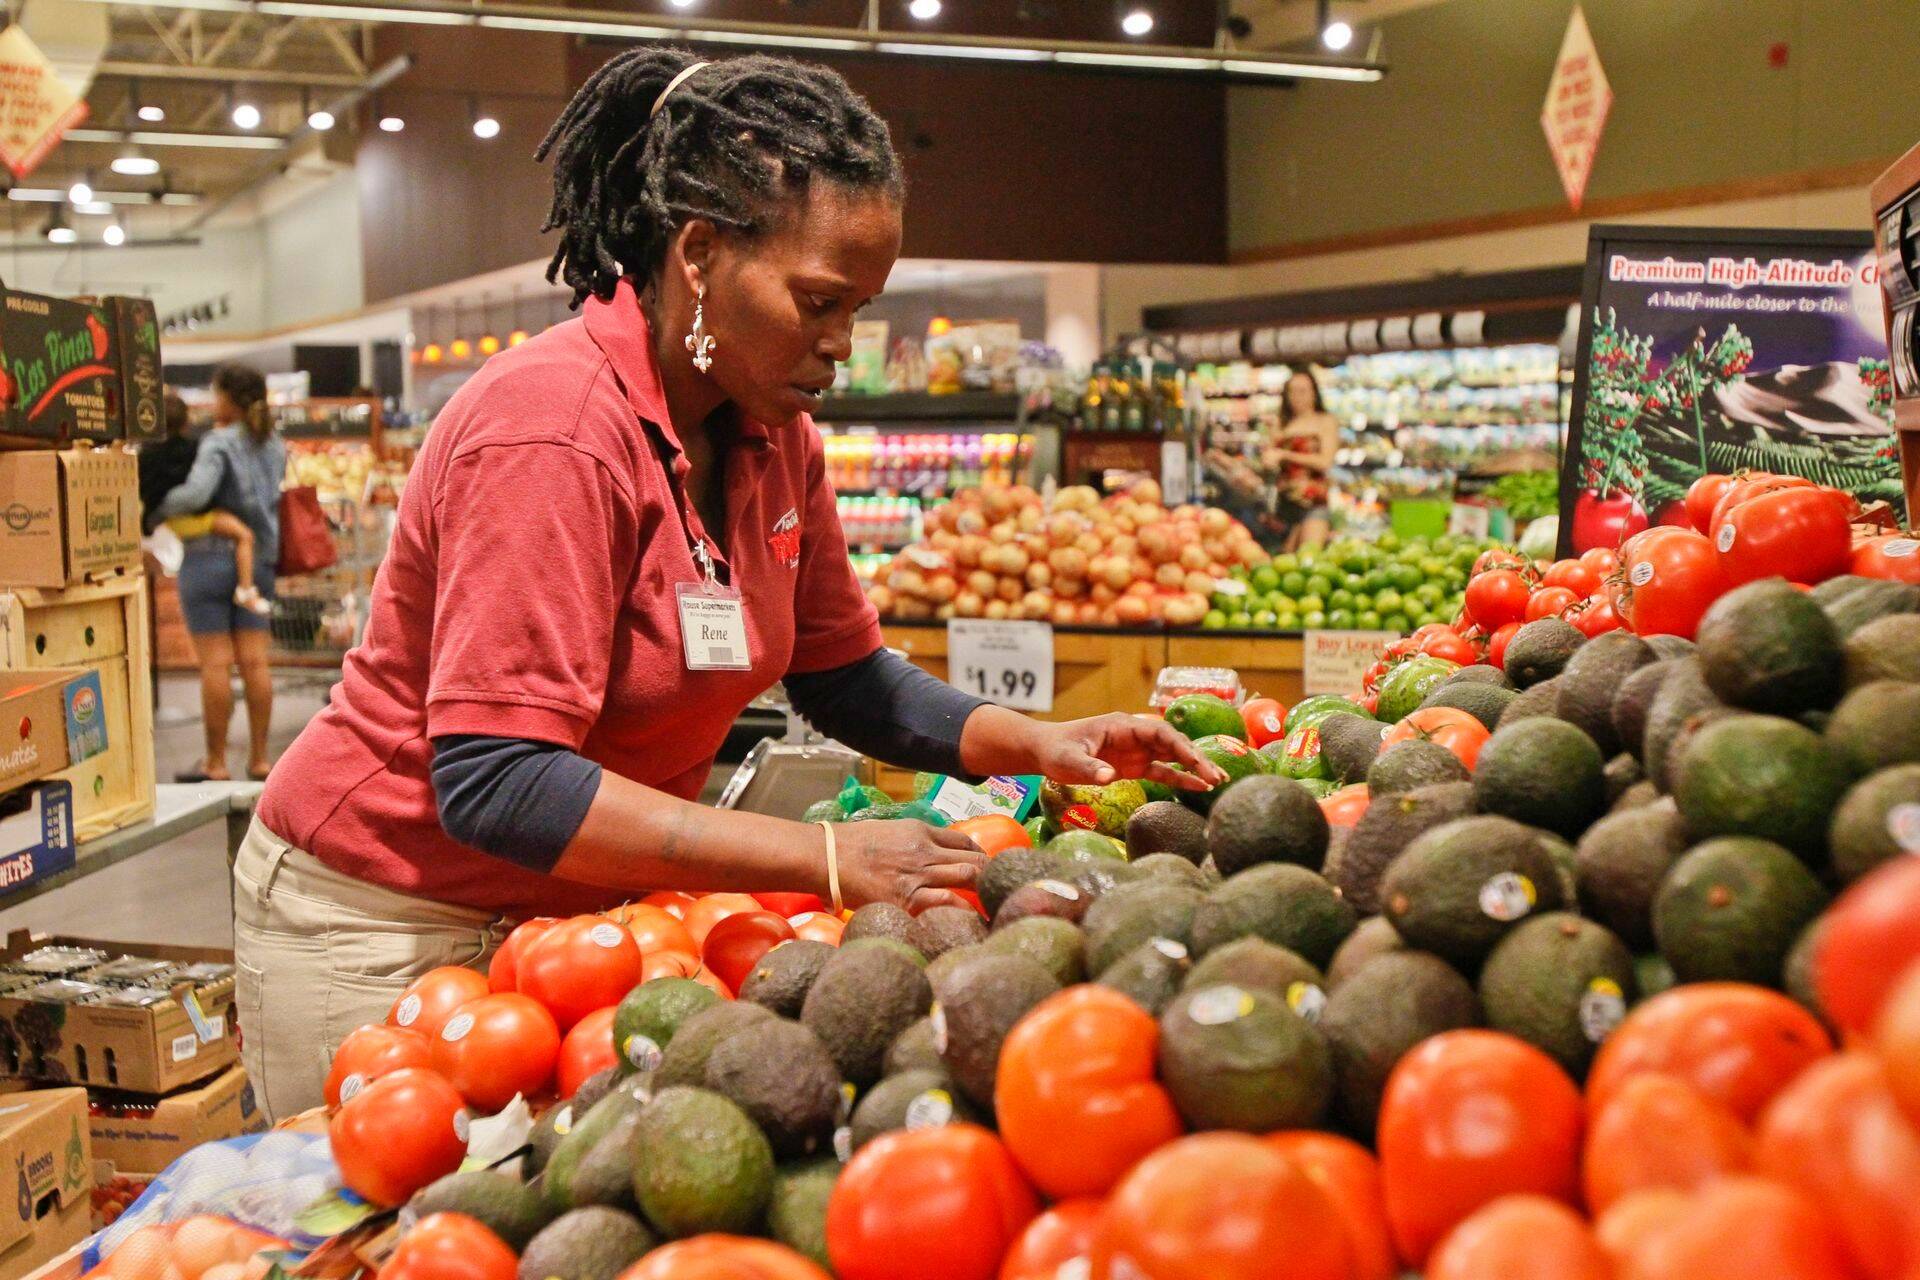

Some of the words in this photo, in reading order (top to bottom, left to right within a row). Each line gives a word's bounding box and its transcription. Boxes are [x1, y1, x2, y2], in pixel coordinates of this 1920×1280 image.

[1610, 256, 1704, 282] Premium
[1707, 258, 1853, 288] High-Altitude
[1647, 291, 1660, 307] A
[1663, 290, 1744, 311] half-mile
[1745, 294, 1796, 312] closer
[1798, 297, 1817, 312] to
[1821, 296, 1850, 312] the
[13, 357, 48, 412] Los
[44, 329, 93, 377] Pinos
[701, 624, 728, 640] Rene
